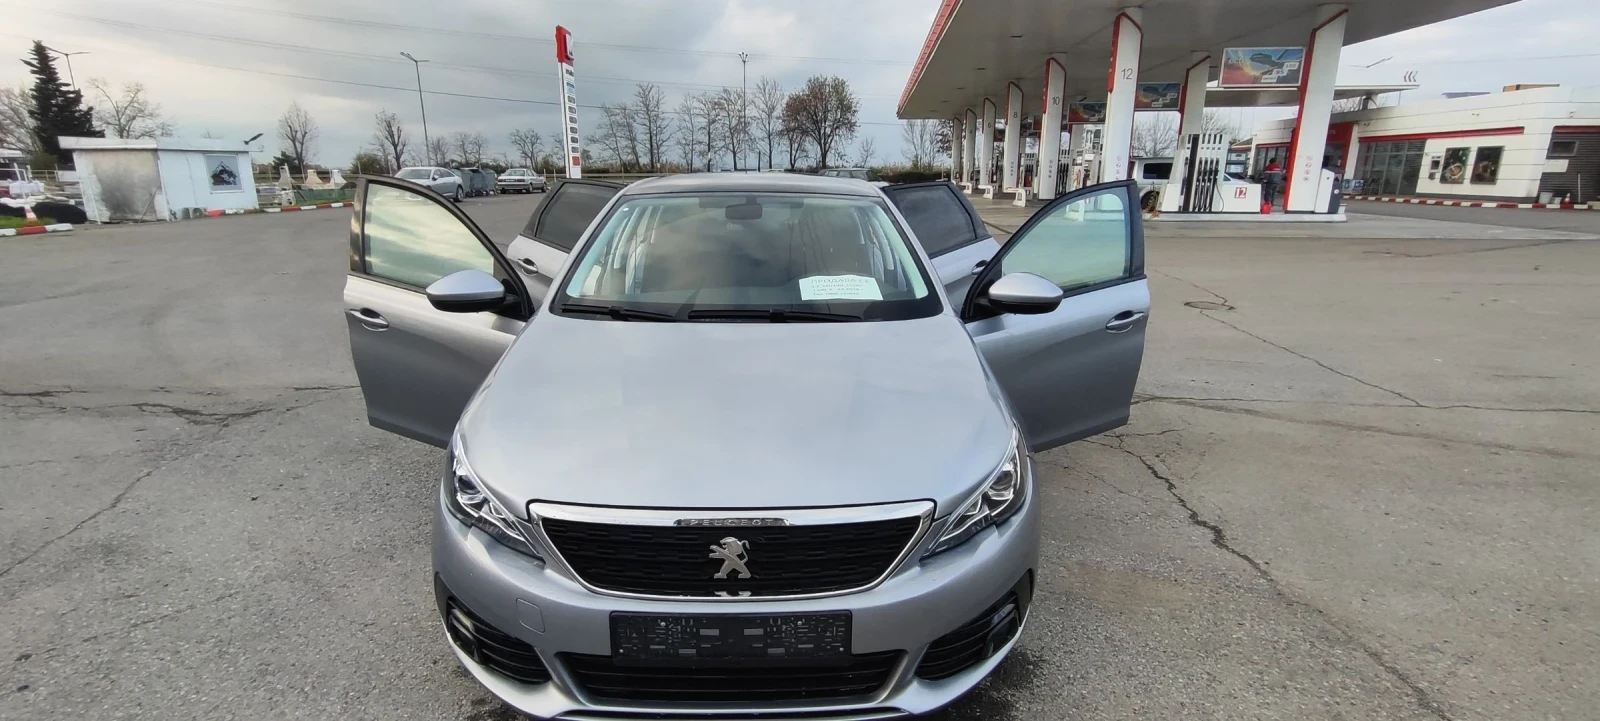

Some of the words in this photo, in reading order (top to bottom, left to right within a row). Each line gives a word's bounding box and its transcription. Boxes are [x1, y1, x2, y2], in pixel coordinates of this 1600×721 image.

[1121, 68, 1133, 80] 12
[1052, 96, 1060, 105] 10
[1235, 187, 1246, 198] 12
